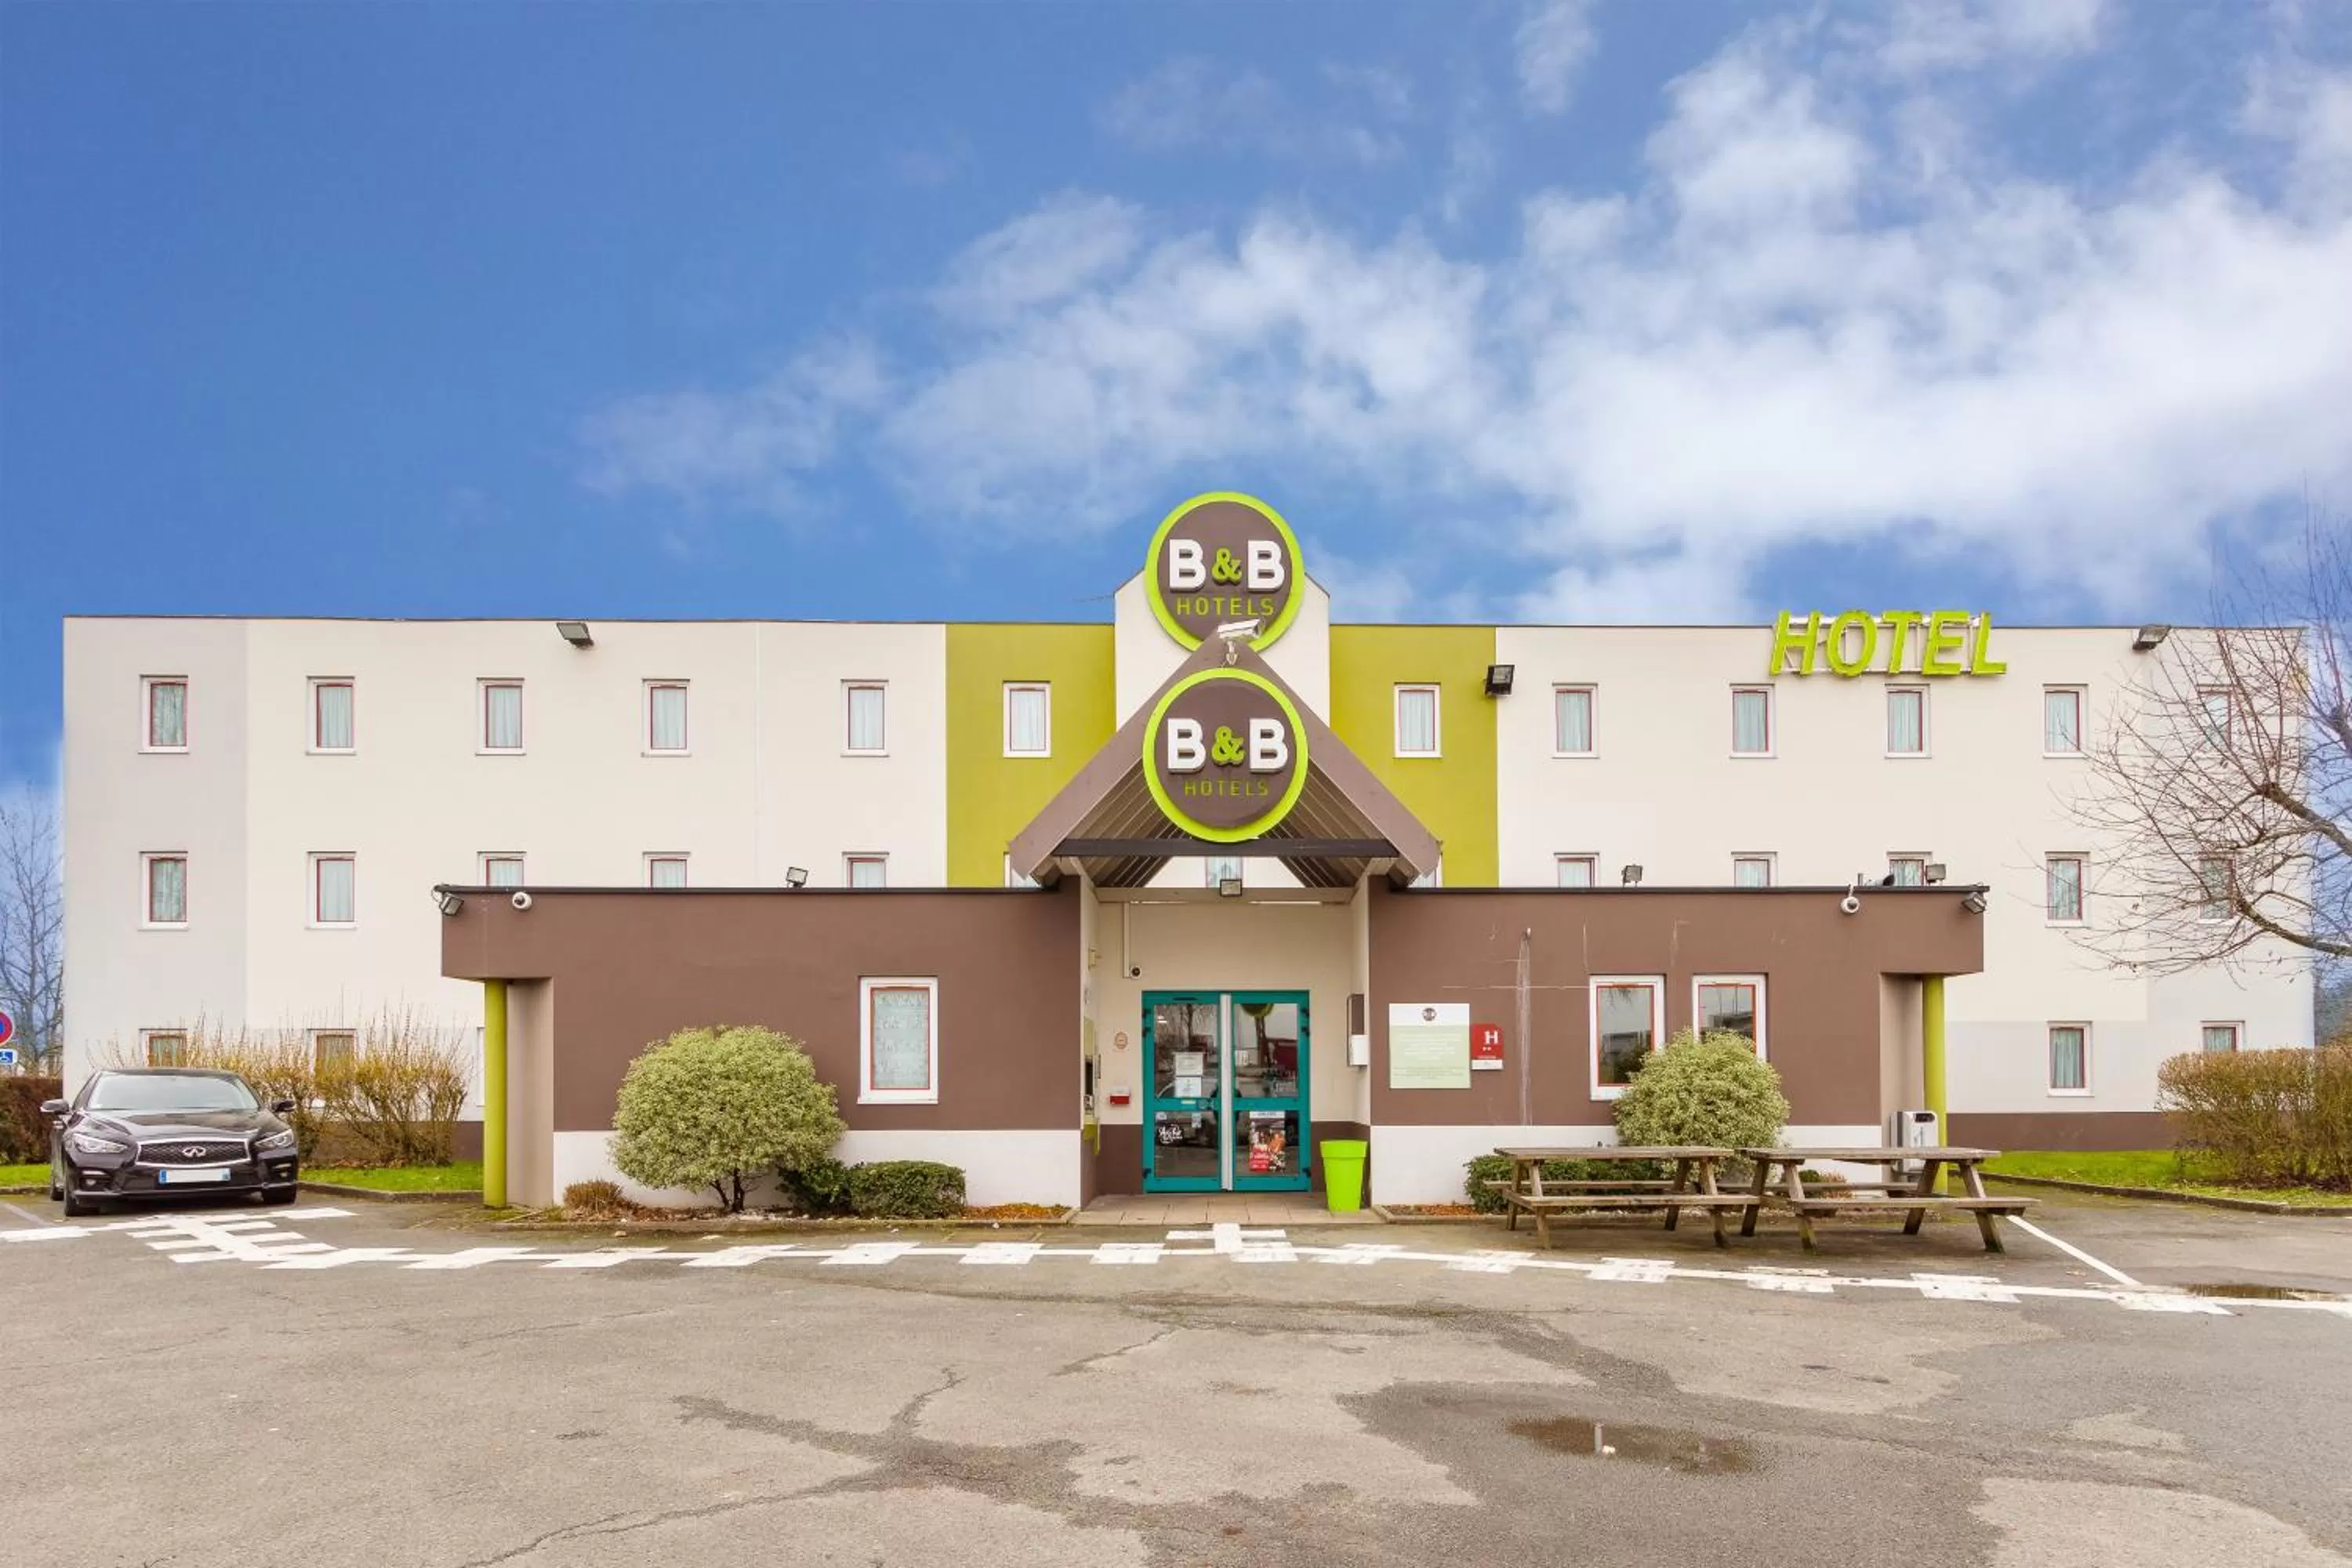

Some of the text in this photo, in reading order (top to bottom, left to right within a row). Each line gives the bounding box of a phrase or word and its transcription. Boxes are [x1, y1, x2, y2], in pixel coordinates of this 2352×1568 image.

[1169, 539, 1285, 592] B&B
[1177, 598, 1275, 616] HOTELS
[1769, 610, 2007, 677] HOTEL
[1167, 717, 1288, 772] B&B
[1185, 780, 1269, 797] HOTELS
[1484, 1030, 1498, 1044] H
